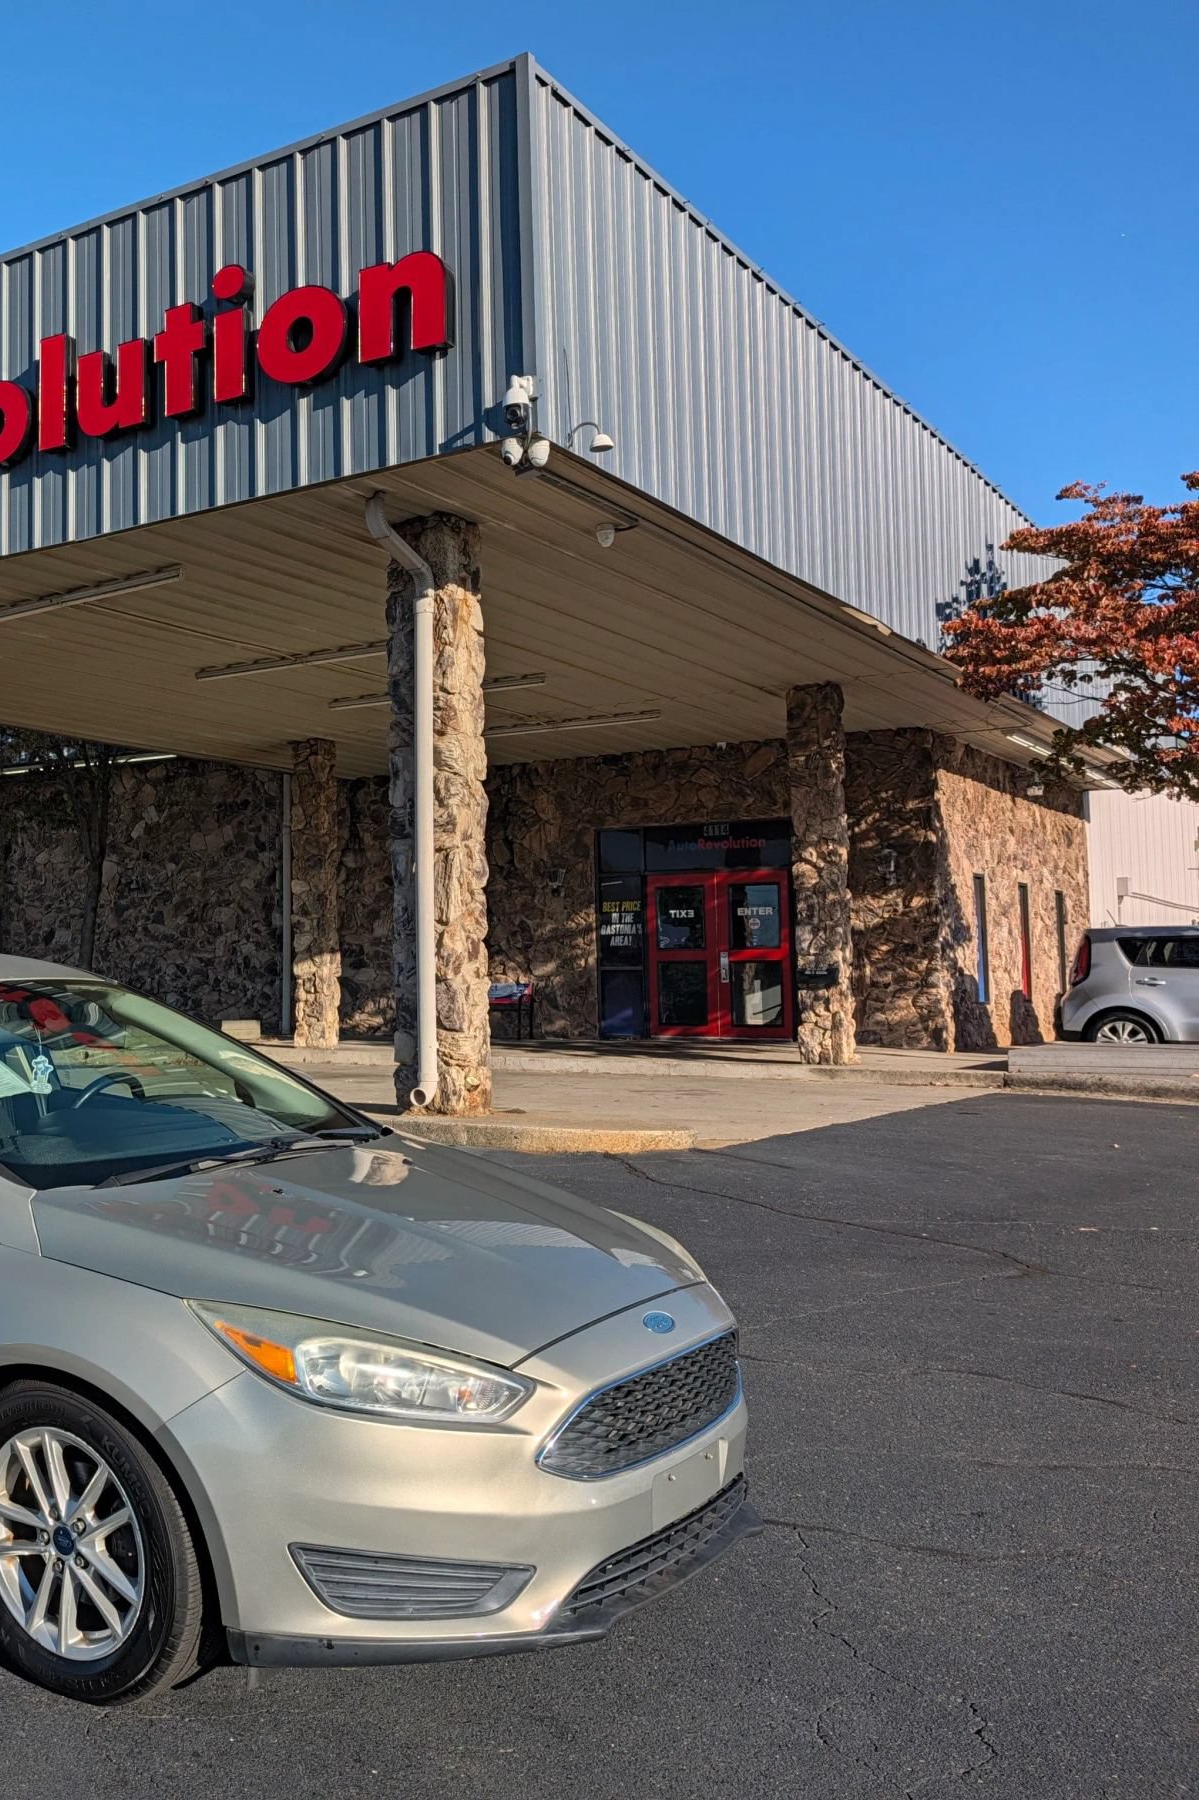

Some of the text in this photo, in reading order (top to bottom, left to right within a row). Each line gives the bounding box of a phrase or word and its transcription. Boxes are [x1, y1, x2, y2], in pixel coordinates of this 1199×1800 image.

[668, 836, 766, 850] AutoRevolution
[602, 900, 642, 913] BEST PRICE
[737, 906, 773, 916] ENTER
[611, 912, 635, 923] IN THE
[600, 923, 642, 936] GASTONIA'S
[609, 935, 632, 947] AREA!
